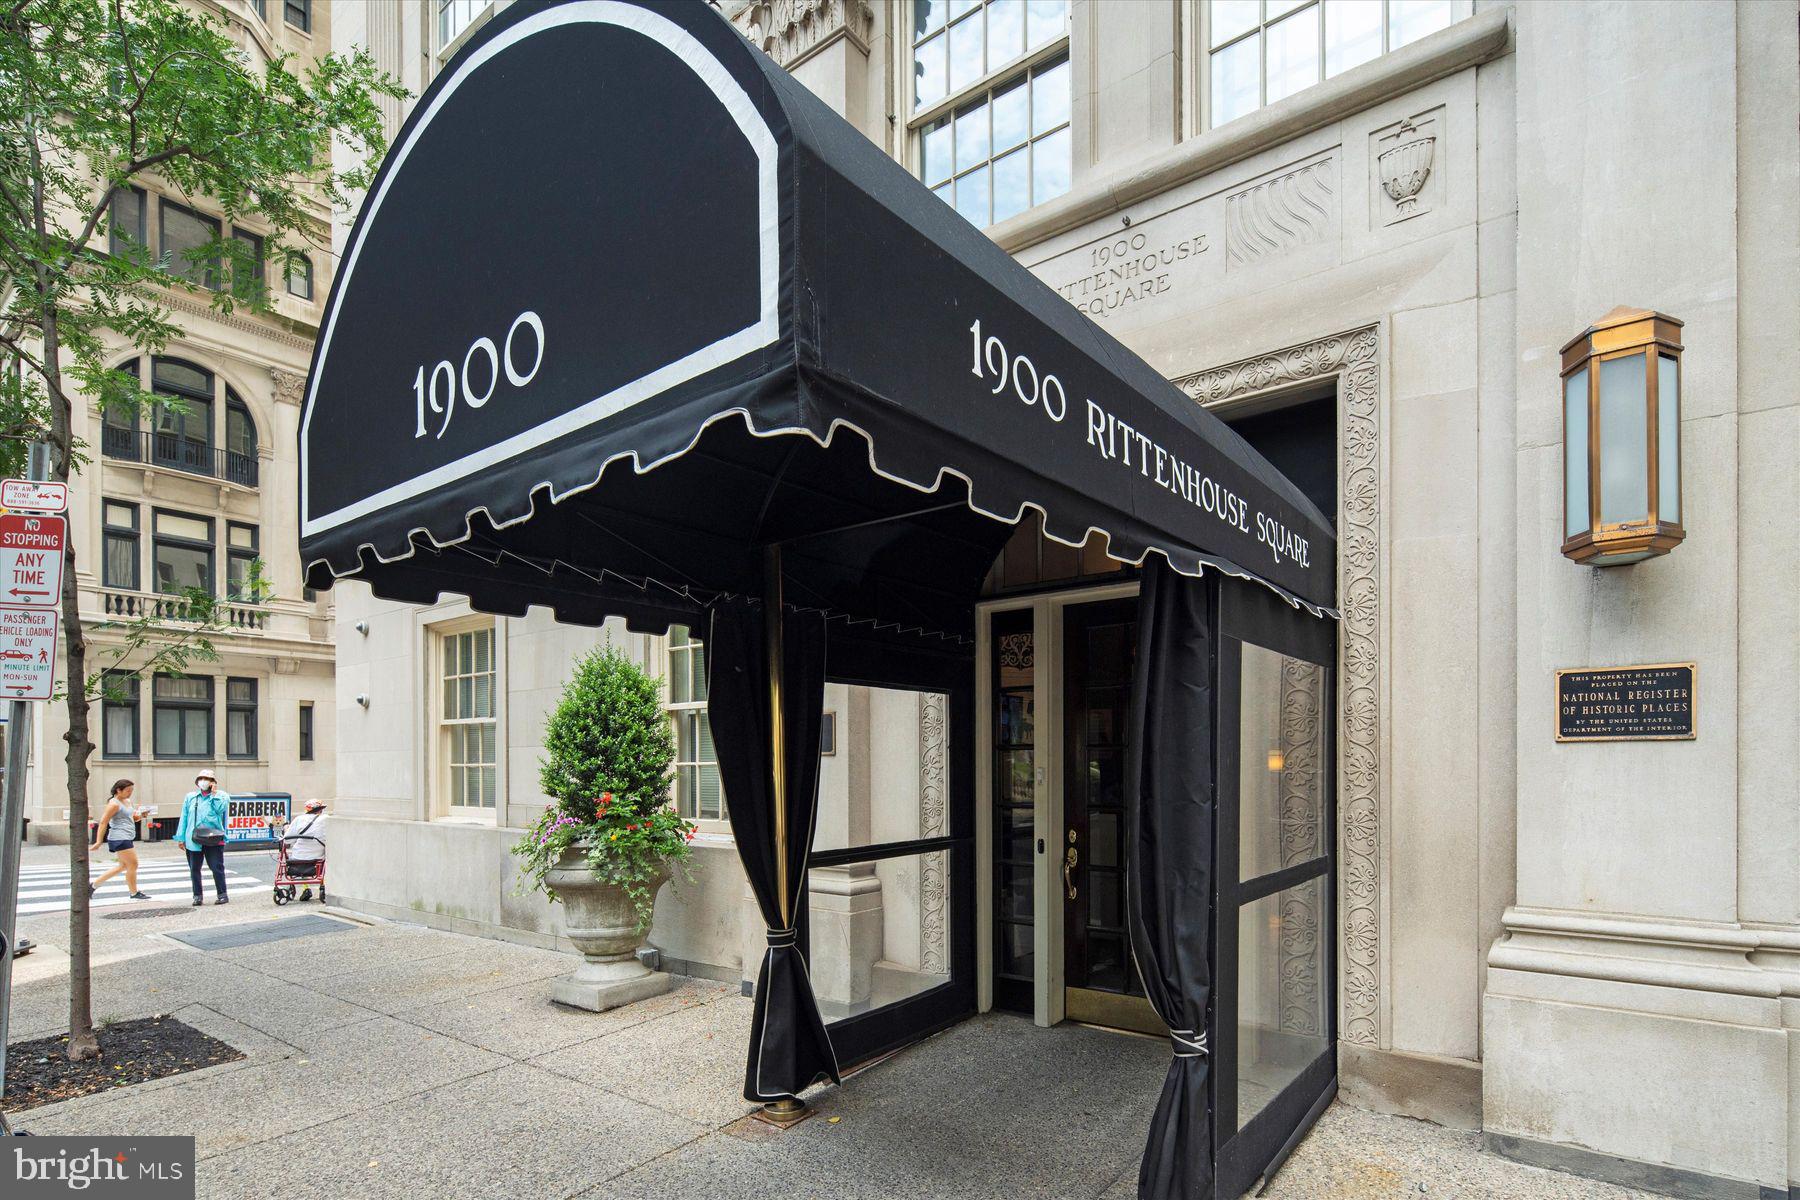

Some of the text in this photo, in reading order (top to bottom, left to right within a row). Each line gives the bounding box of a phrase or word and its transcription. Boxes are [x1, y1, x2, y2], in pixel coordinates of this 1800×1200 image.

[1091, 233, 1147, 268] 1900
[1057, 234, 1210, 301] TTENHOUSE
[1077, 273, 1172, 318] SQUARE
[413, 310, 545, 440] 1900
[969, 318, 1310, 568] 1900 RITTENHOUSE SQUARE
[24, 518, 41, 531] NO
[3, 532, 59, 547] STOPPING
[15, 552, 45, 567] ANY
[13, 569, 45, 585] TIME
[3, 614, 47, 625] PASSENGER
[0, 626, 54, 637] EHICLE LOADING
[14, 637, 33, 647] ONLY
[4, 663, 30, 671] MINUTE
[3, 673, 38, 681] MON-SUN
[1592, 673, 1632, 681] PROPERTY
[1562, 688, 1688, 703] NATIONAL REGISTER
[1563, 702, 1688, 715] OF HISTORIC PLACES
[228, 801, 286, 817] BARBERA
[228, 817, 265, 829] JEEPS
